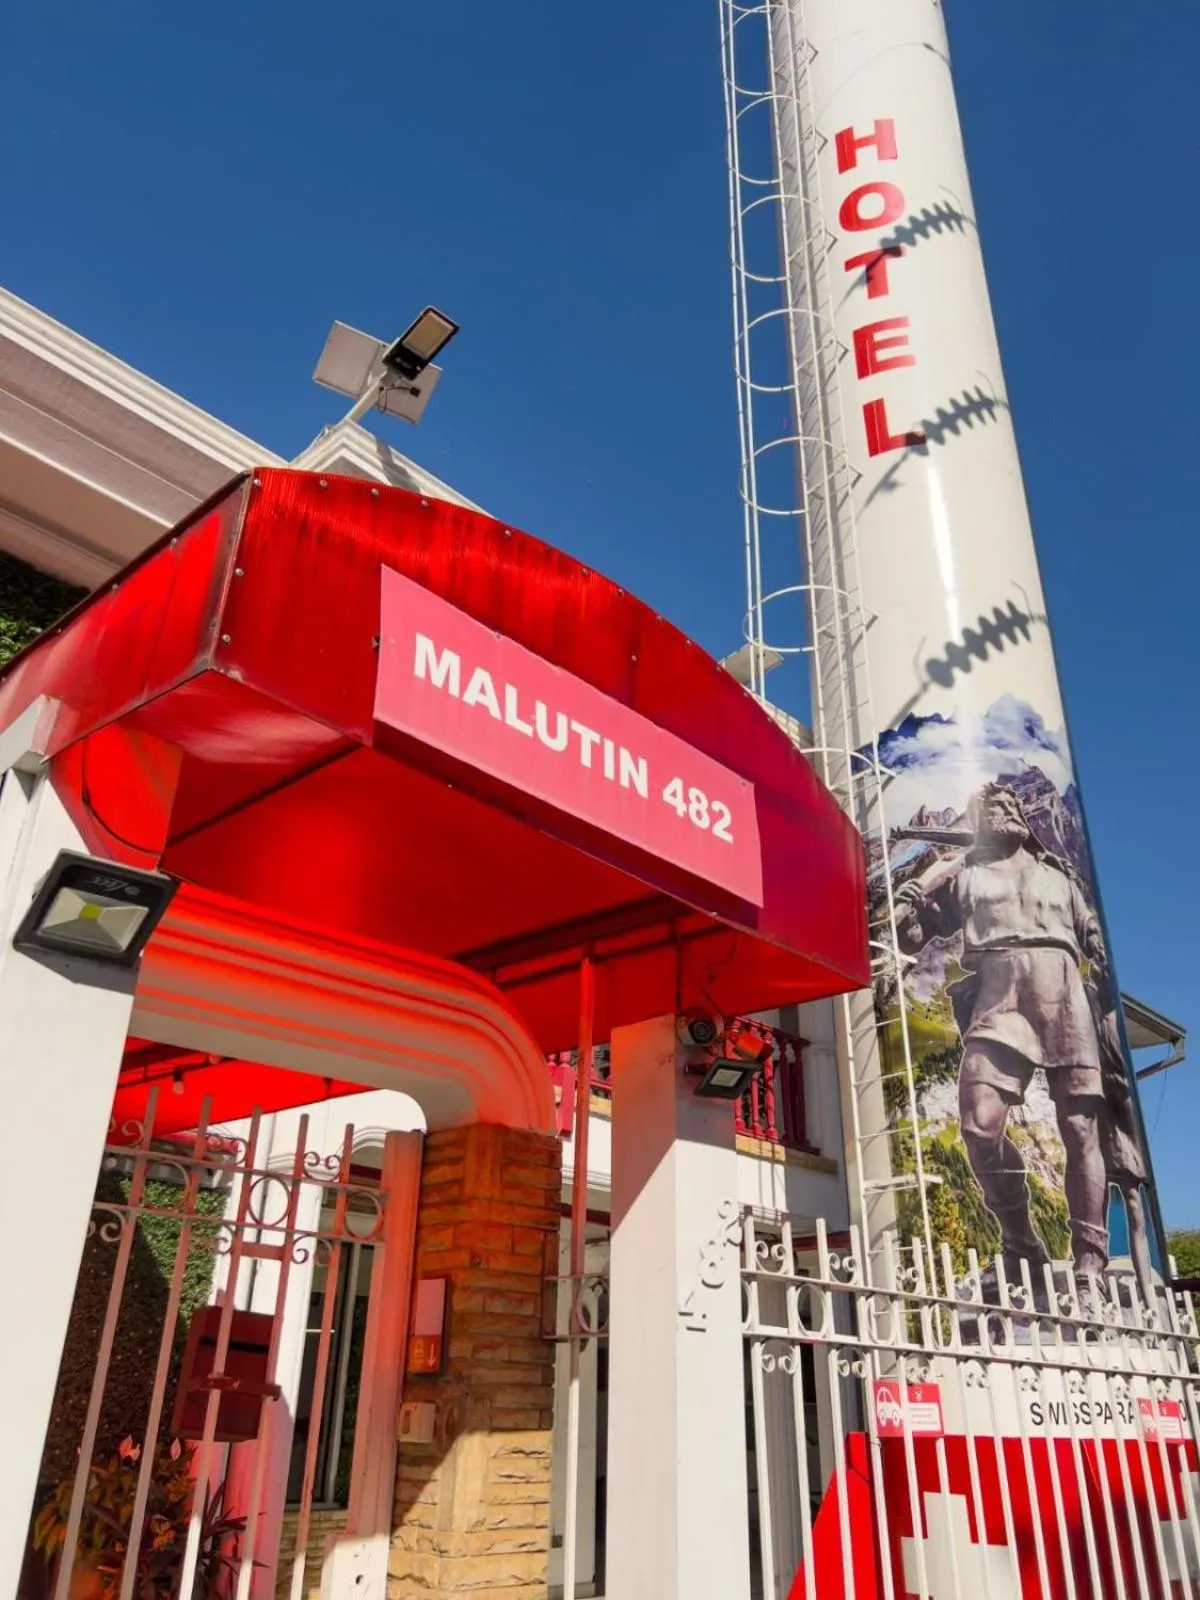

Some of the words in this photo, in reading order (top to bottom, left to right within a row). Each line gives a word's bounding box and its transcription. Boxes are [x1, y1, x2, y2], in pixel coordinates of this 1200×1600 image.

[834, 118, 927, 458] HOTEL
[413, 632, 648, 799] MALUTIN
[662, 776, 734, 844] 482
